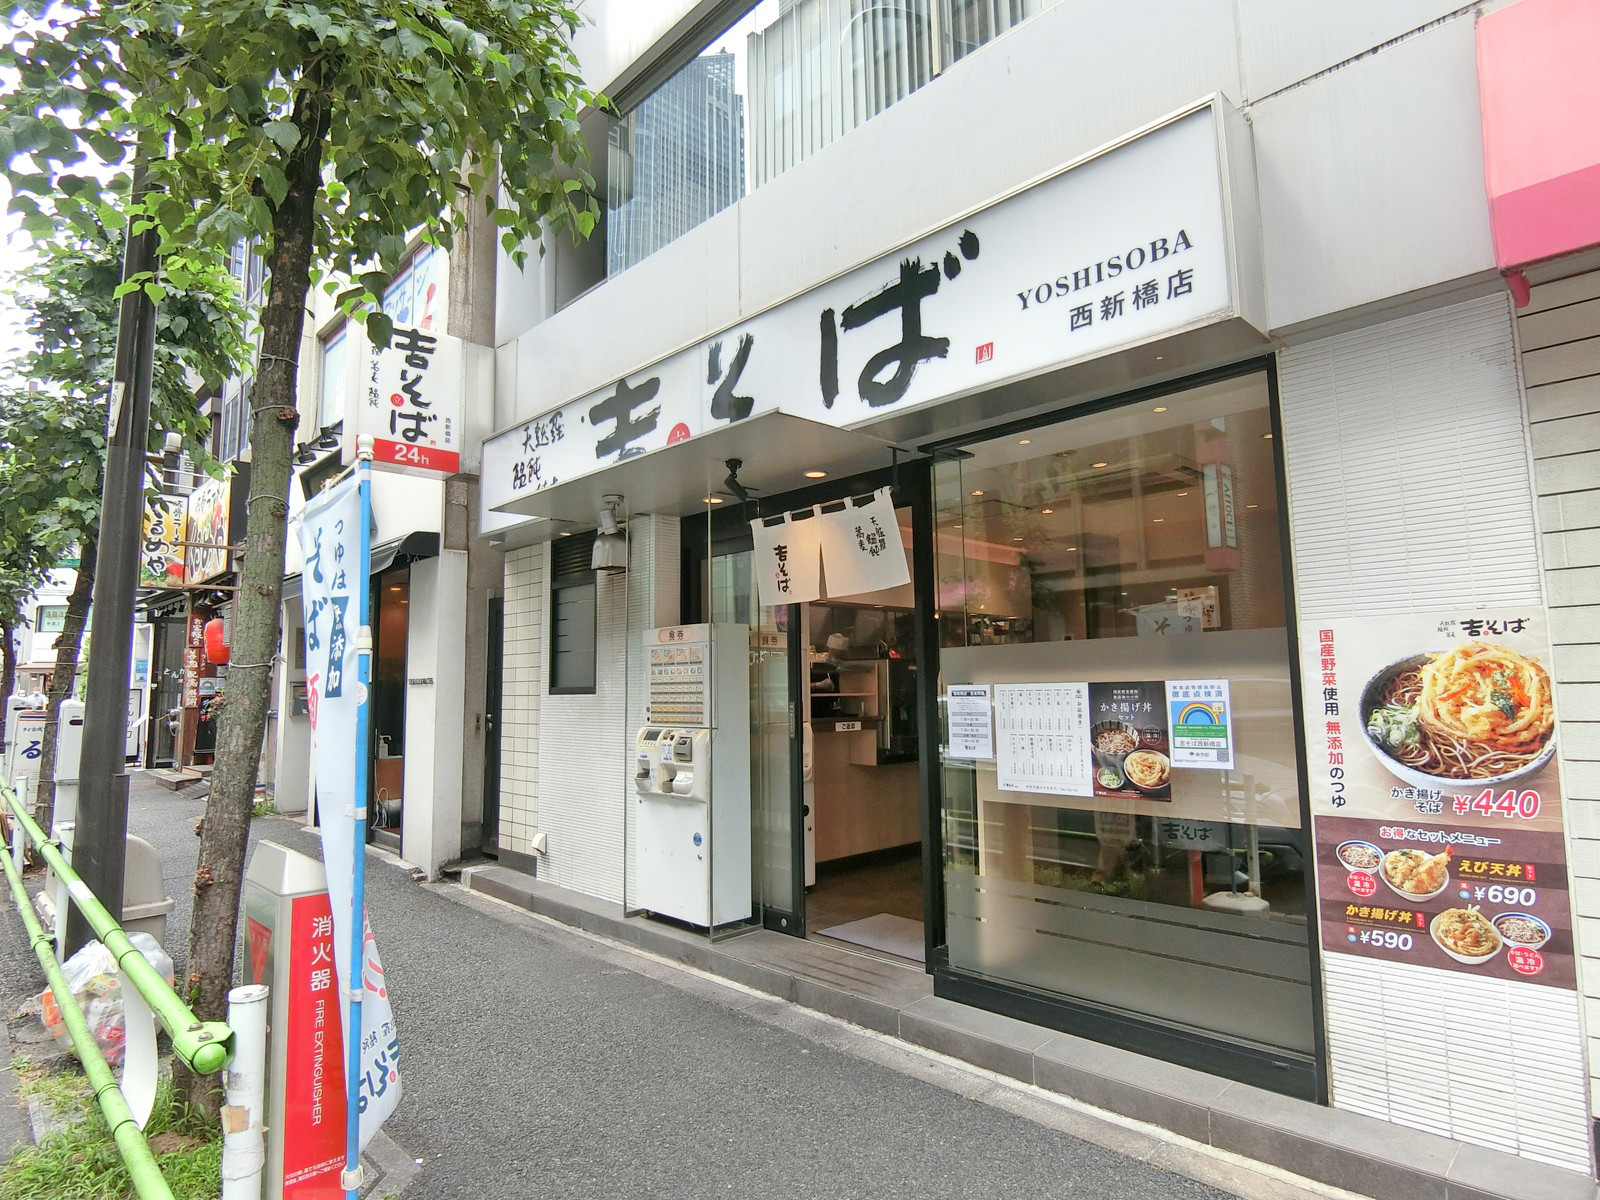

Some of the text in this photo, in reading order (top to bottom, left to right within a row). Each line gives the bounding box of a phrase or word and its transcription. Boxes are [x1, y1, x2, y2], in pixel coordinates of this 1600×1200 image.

[1016, 229, 1194, 312] YOSHISOBA
[1068, 267, 1195, 333] 西新橋店
[389, 328, 438, 443] 吉そば
[394, 444, 430, 465] 24h
[773, 544, 792, 593] 吉そば
[668, 629, 685, 642] 食券
[1460, 617, 1531, 637] 吉そば
[1100, 701, 1153, 714] かき揚げ丼
[1117, 713, 1135, 721] セット
[1318, 628, 1347, 809] 国産野菜使用 無添加のつゆ
[20, 740, 42, 760] る
[1390, 786, 1443, 801] かき揚げ
[1452, 788, 1542, 819] ¥440
[1413, 801, 1443, 815] そば
[1379, 827, 1501, 847] お得なセットメニュー
[1458, 859, 1523, 877] えび天丼
[1473, 885, 1537, 907] ¥690
[1346, 904, 1413, 924] かき揚げ丼
[1359, 929, 1414, 951] ¥590
[310, 915, 332, 992] 消火器
[312, 999, 325, 1127] FIRE EXTINGUISHER
